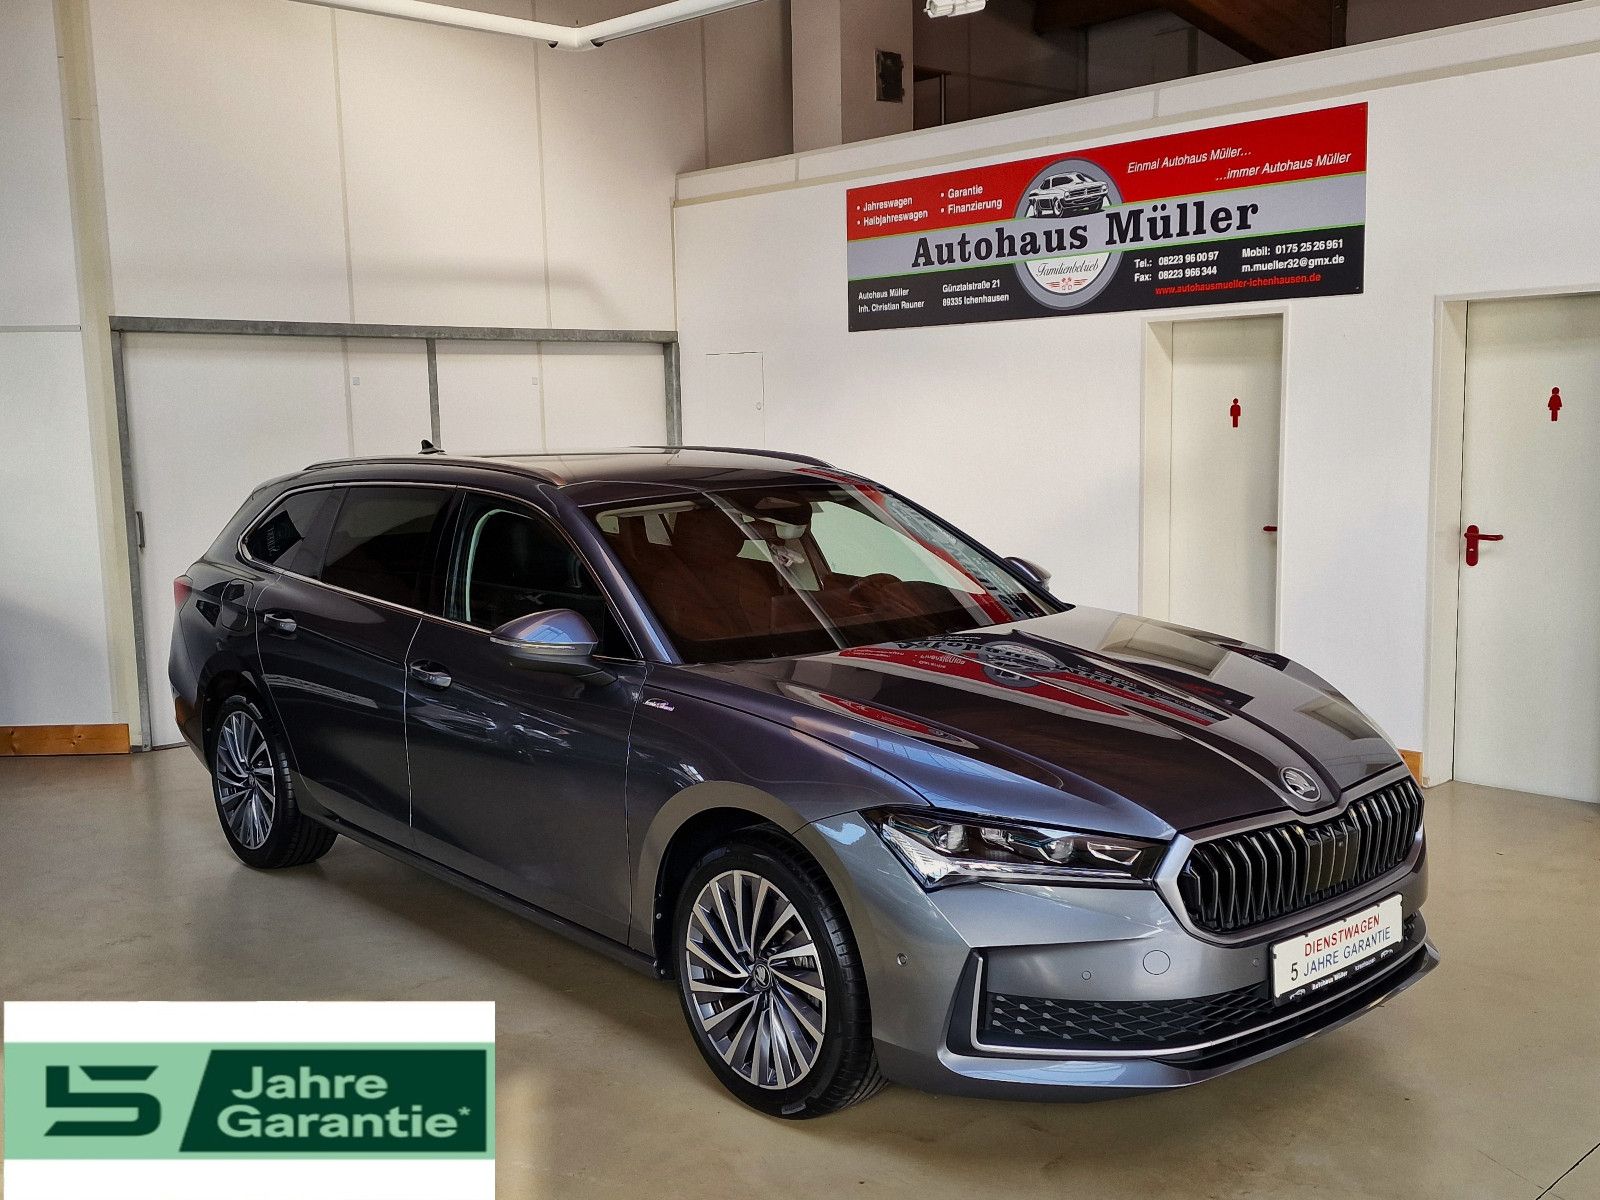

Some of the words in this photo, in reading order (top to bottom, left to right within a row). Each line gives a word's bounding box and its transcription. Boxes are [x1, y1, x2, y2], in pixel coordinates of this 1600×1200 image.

[1128, 157, 1159, 174] Einmal
[1162, 152, 1207, 168] Autohaus
[1261, 159, 1313, 175] Autohaus
[1315, 152, 1351, 166] Müller
[948, 185, 983, 199] Garantie
[863, 197, 913, 212] Jahreswagen
[948, 199, 1003, 215] Finanzierung
[864, 209, 928, 227] Halbjahreswagen
[911, 224, 1088, 268] Autohaus
[1105, 200, 1259, 246] Müller
[1241, 247, 1271, 258] Mobil:
[1275, 243, 1298, 255] 0175
[1134, 258, 1152, 269] Tel.:
[1158, 256, 1184, 267] 08223
[1241, 254, 1345, 273] m.mueller32@gmx.de
[1134, 271, 1152, 282] Fax:
[1158, 269, 1184, 280] 08223
[991, 279, 1001, 289] 21
[1155, 273, 1322, 295] www.autohausmueller-ichenhausen.de
[858, 290, 888, 300] Autohaus
[889, 287, 910, 297] Müller
[964, 293, 1010, 305] Ichenhausen
[858, 304, 871, 313] Inh.
[871, 301, 900, 312] Christian
[1304, 913, 1380, 957] DIENSTWAGEN
[1291, 962, 1299, 982] 5
[1303, 953, 1339, 977] JAHRE
[1343, 926, 1391, 960] GARANTIE
